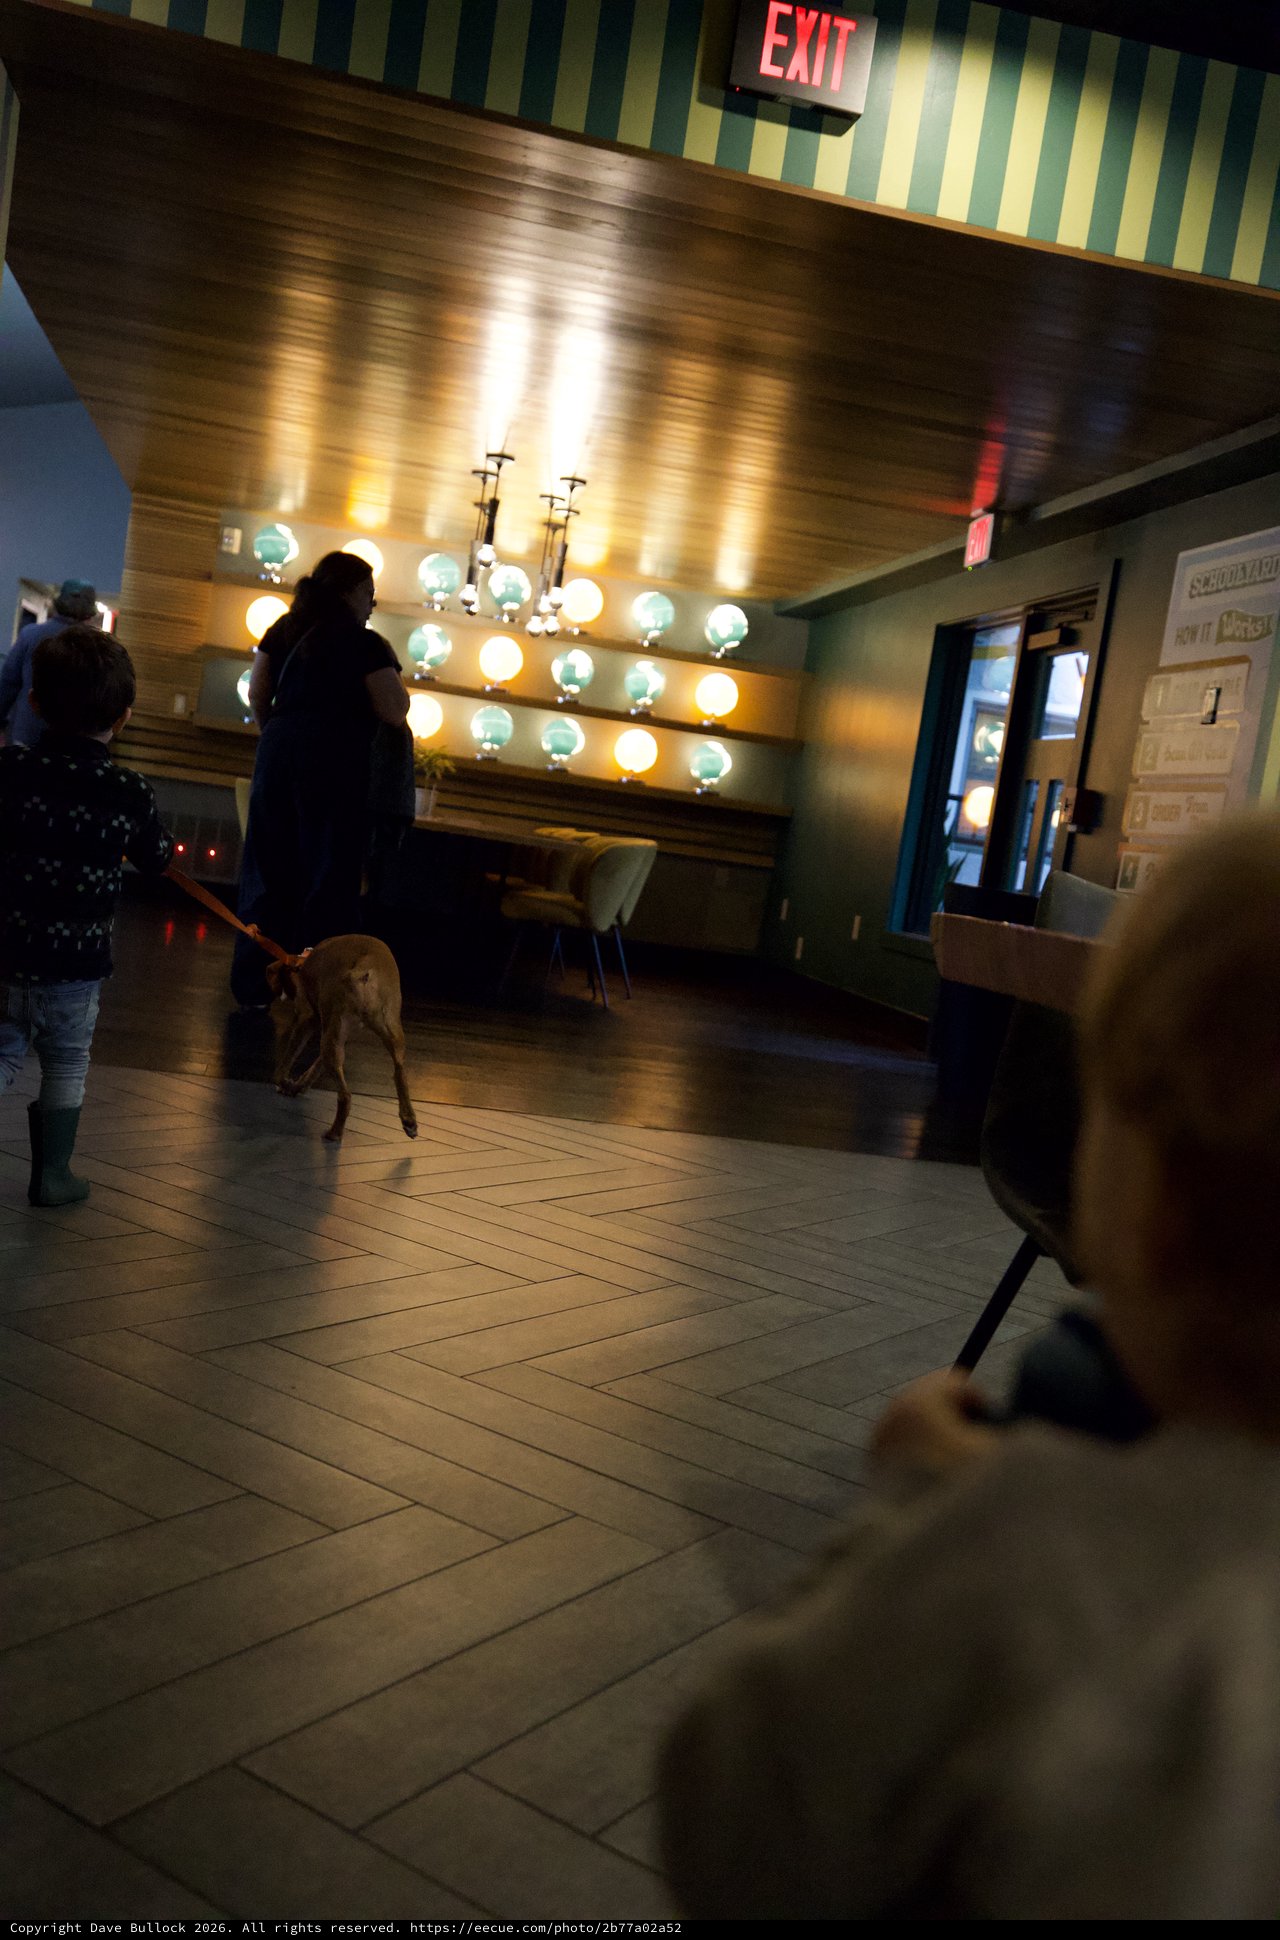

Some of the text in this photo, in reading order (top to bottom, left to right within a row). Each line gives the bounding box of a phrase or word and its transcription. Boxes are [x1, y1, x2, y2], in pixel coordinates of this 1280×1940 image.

[759, 0, 857, 92] EXIT
[966, 515, 991, 562] EXIT
[1176, 624, 1198, 646] HOW
[1201, 622, 1212, 643] IT
